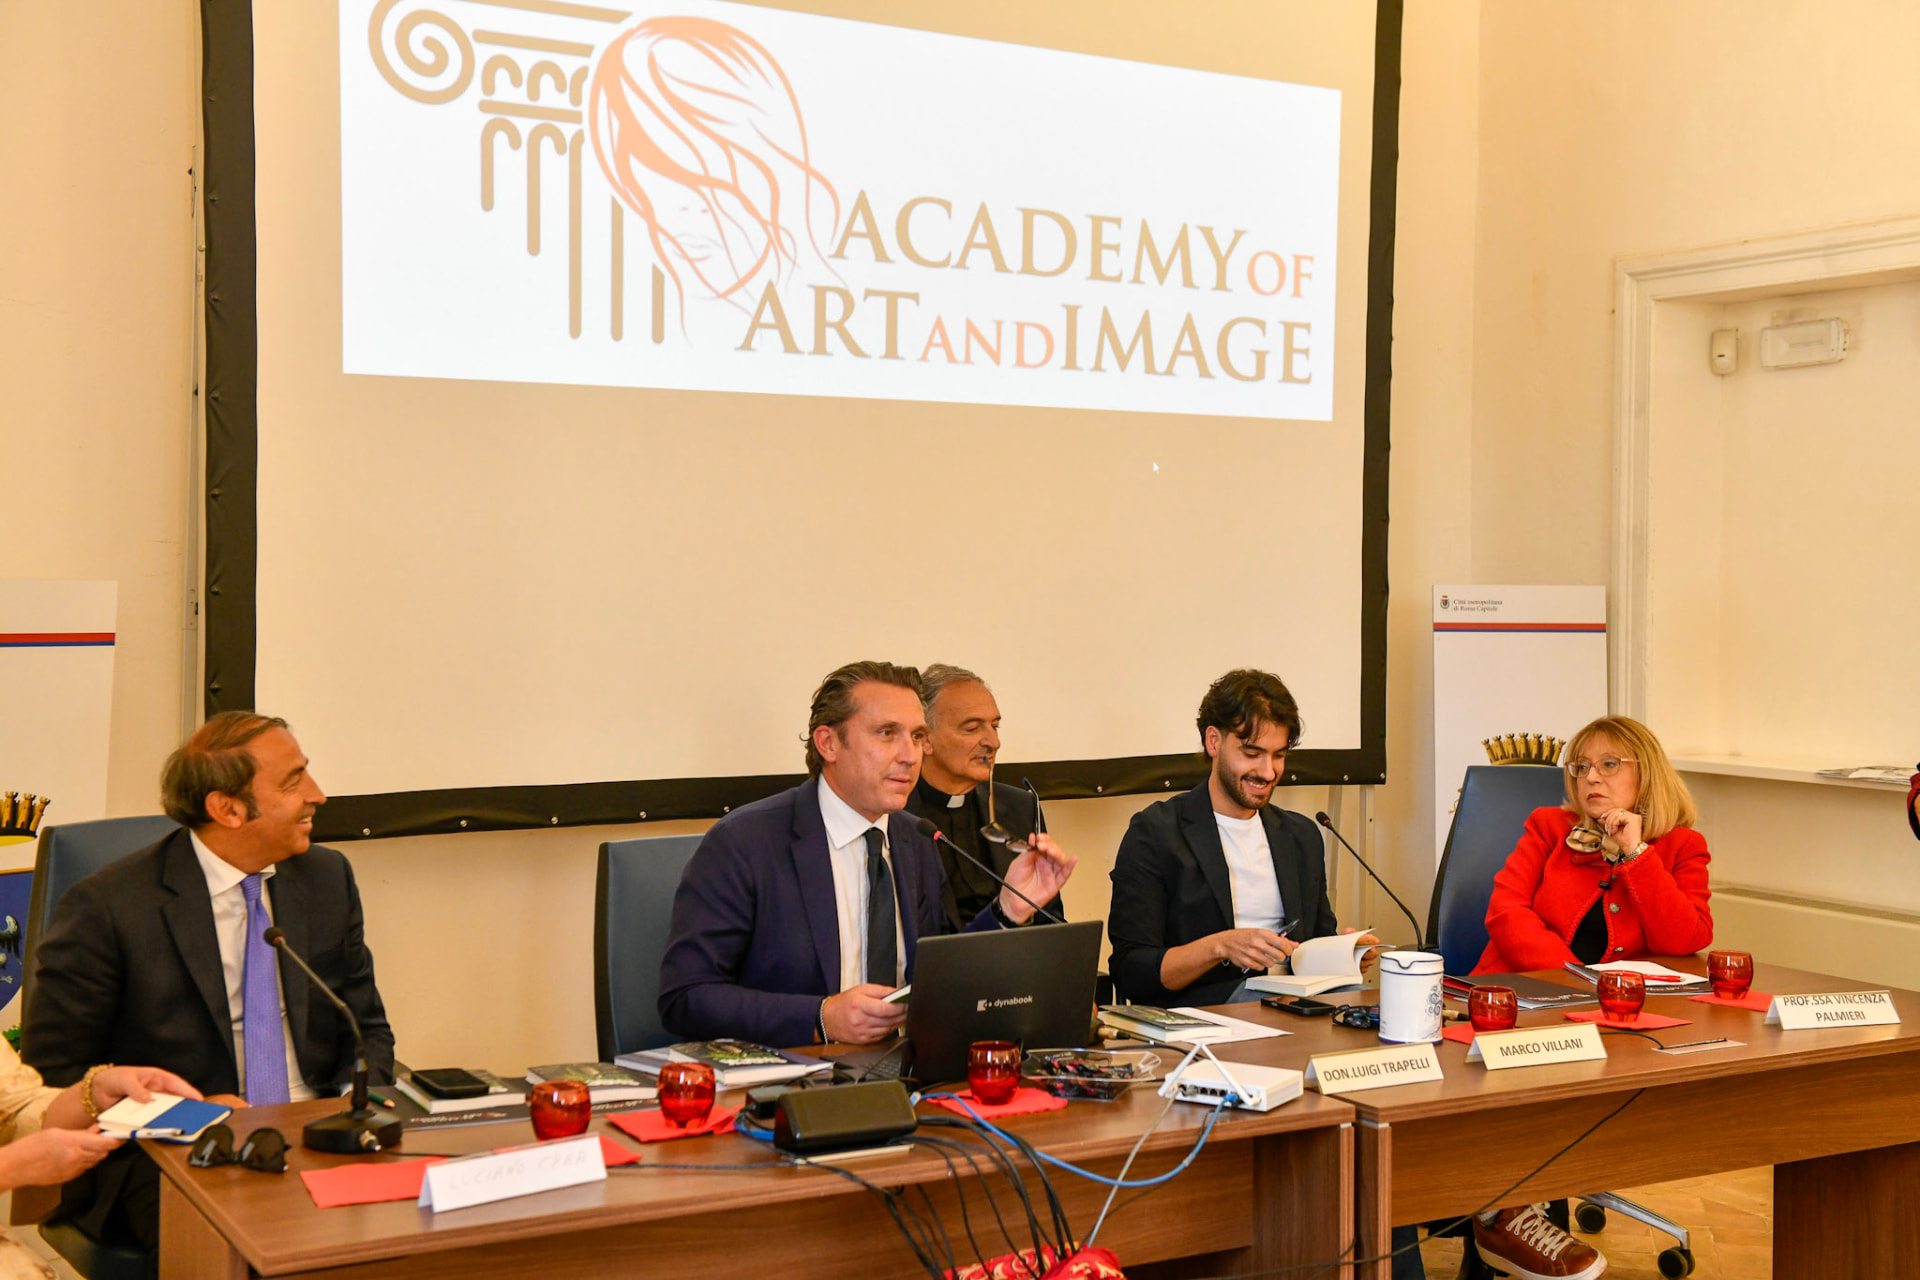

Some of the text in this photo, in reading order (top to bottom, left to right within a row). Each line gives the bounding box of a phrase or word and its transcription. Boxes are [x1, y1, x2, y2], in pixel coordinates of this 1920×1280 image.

[828, 189, 1314, 298] ACADEMY OF
[734, 279, 1312, 385] ART AND IMAGE
[993, 994, 1033, 1008] dynabook
[1833, 993, 1886, 1005] VINCENZA
[1815, 1010, 1866, 1022] PALMIERI
[1499, 1038, 1584, 1057] MARCO VILLANI
[1323, 1057, 1431, 1082] DON.LUIGI TRAPELLI
[449, 1158, 526, 1190] LUCIANO
